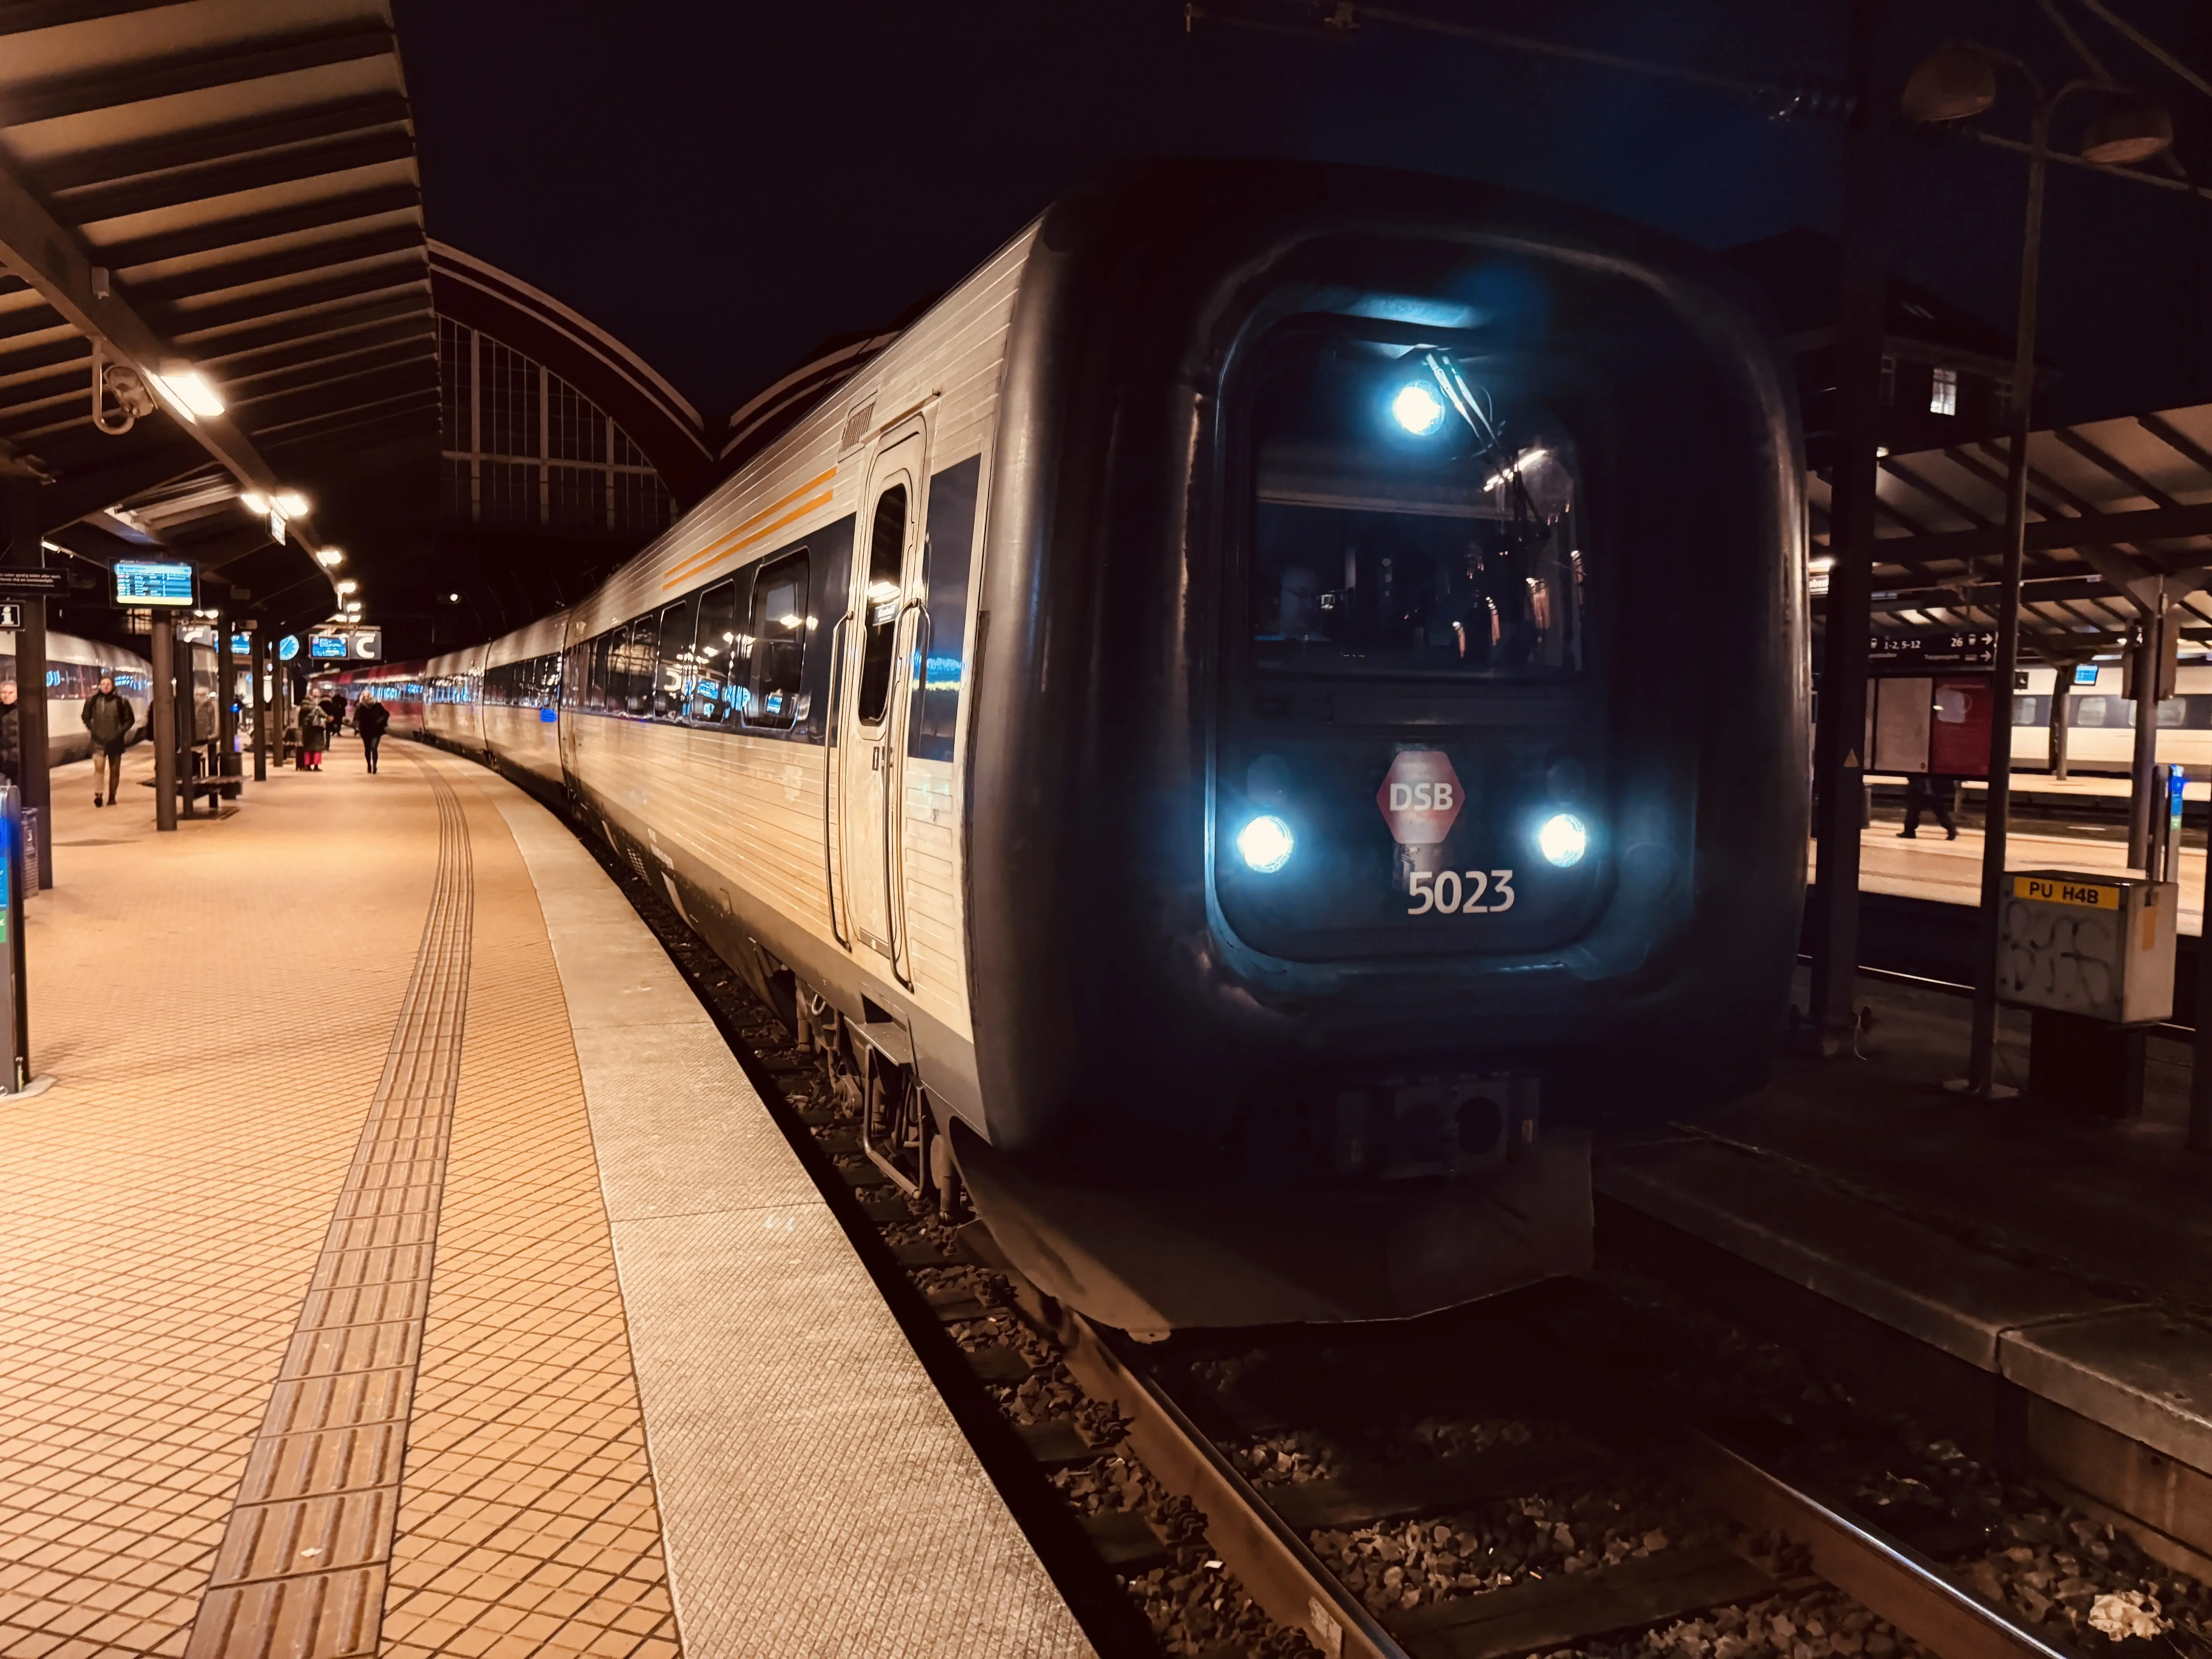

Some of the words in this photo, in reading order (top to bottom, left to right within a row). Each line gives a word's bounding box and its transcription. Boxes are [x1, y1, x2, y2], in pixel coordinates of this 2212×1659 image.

[356, 637, 374, 658] C
[1951, 638, 1963, 647] 26
[1390, 783, 1453, 811] DSB
[1408, 870, 1515, 915] 5023
[2029, 881, 2052, 898] PU
[2062, 886, 2099, 904] H4B
